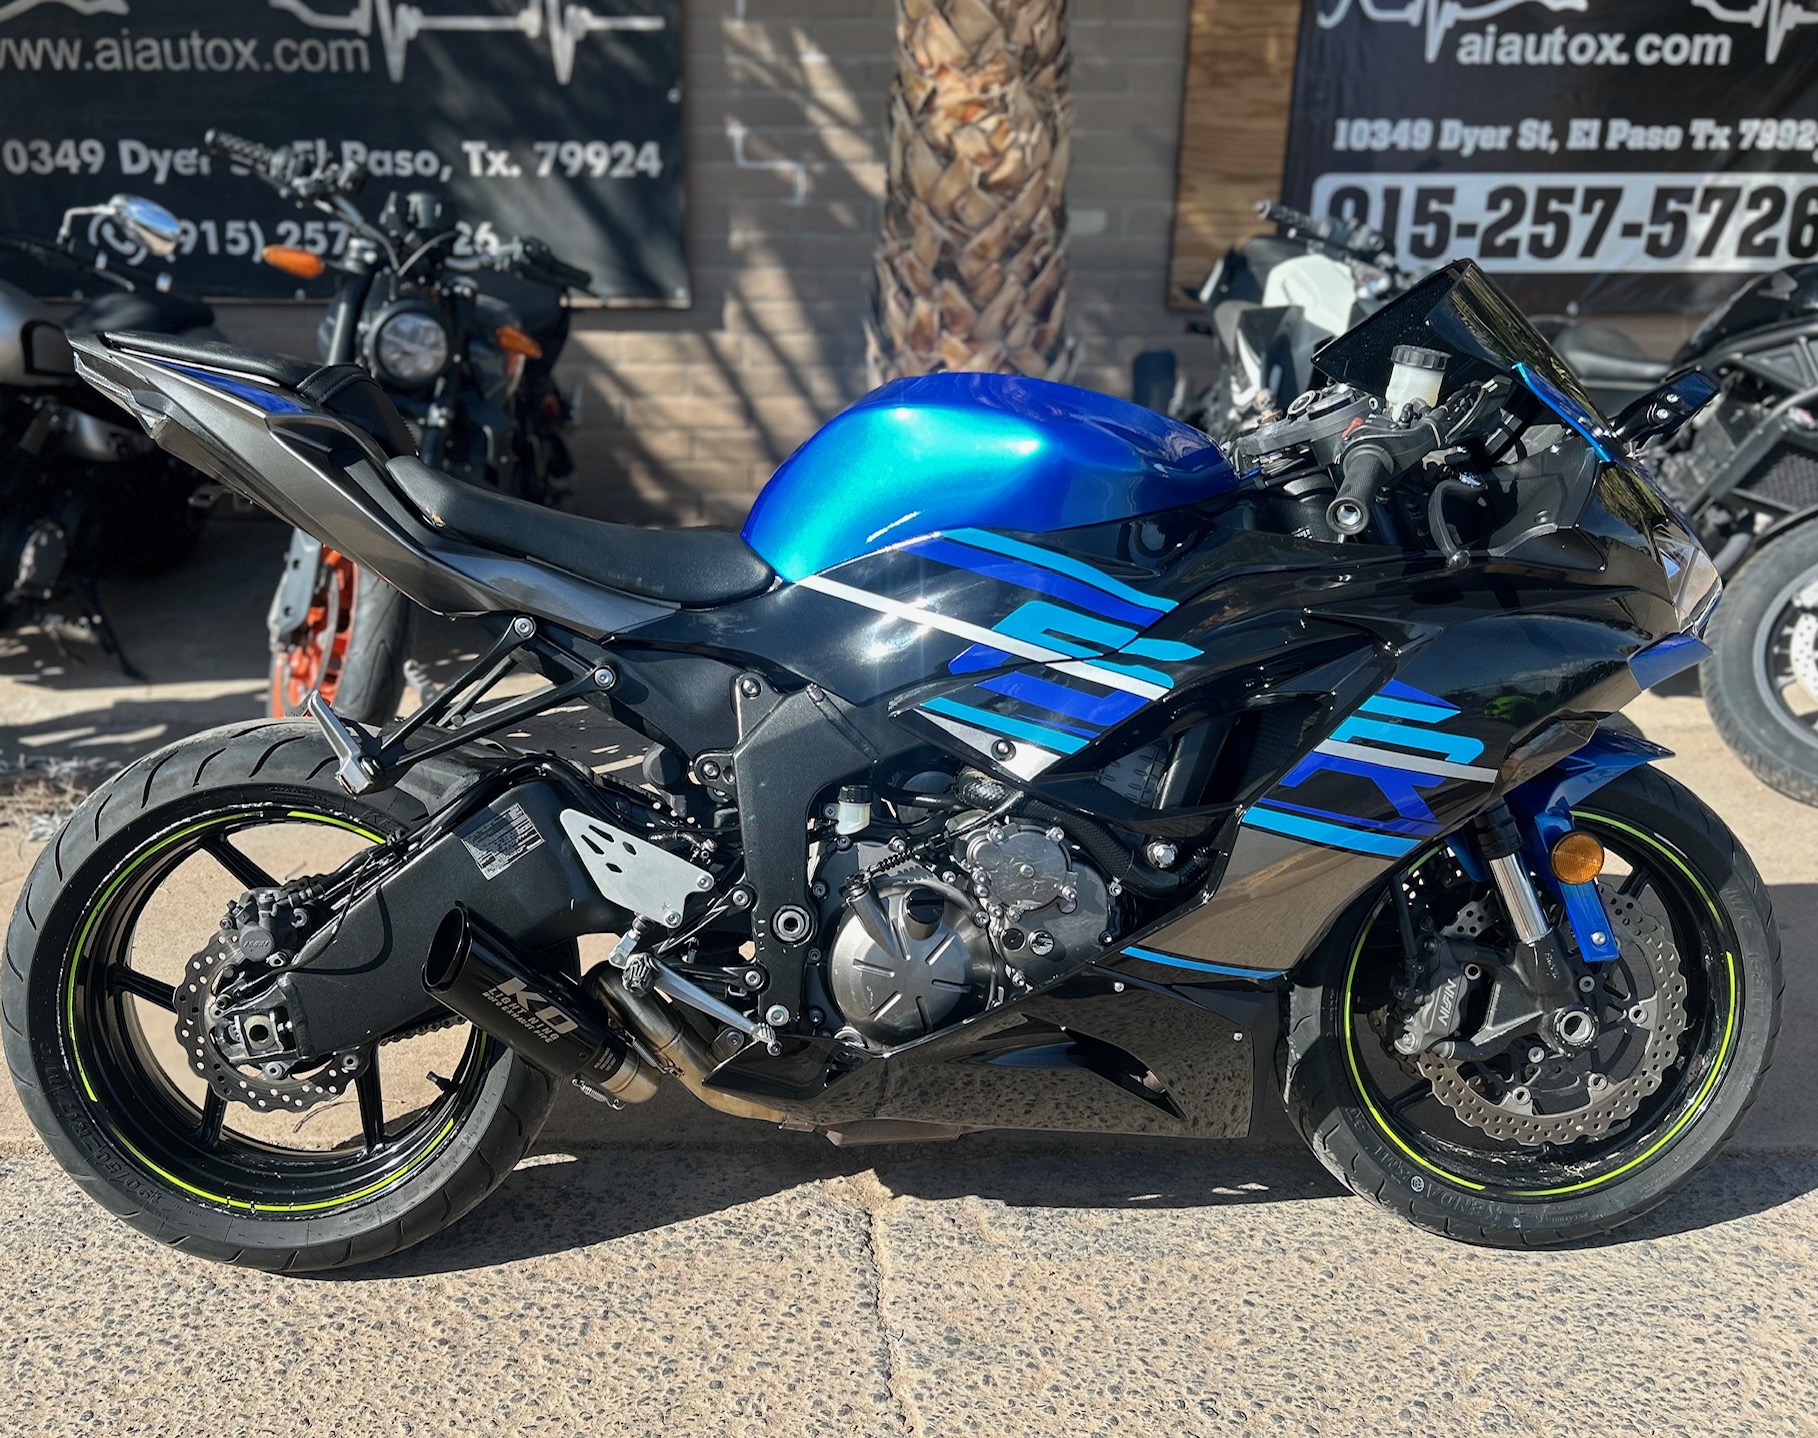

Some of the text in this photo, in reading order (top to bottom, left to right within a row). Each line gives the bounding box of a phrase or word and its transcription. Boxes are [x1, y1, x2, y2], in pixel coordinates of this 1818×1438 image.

[0, 27, 371, 72] ww.aiautox.com
[1455, 24, 1733, 67] aiautox.com
[1333, 117, 1818, 158] 10349 Dyer St, El Paso Tx 7992
[340, 139, 454, 183] Paso,
[460, 139, 522, 178] Tx.
[533, 139, 664, 179] 79924
[495, 976, 579, 1035] KO
[501, 1004, 536, 1031] EXHAUST
